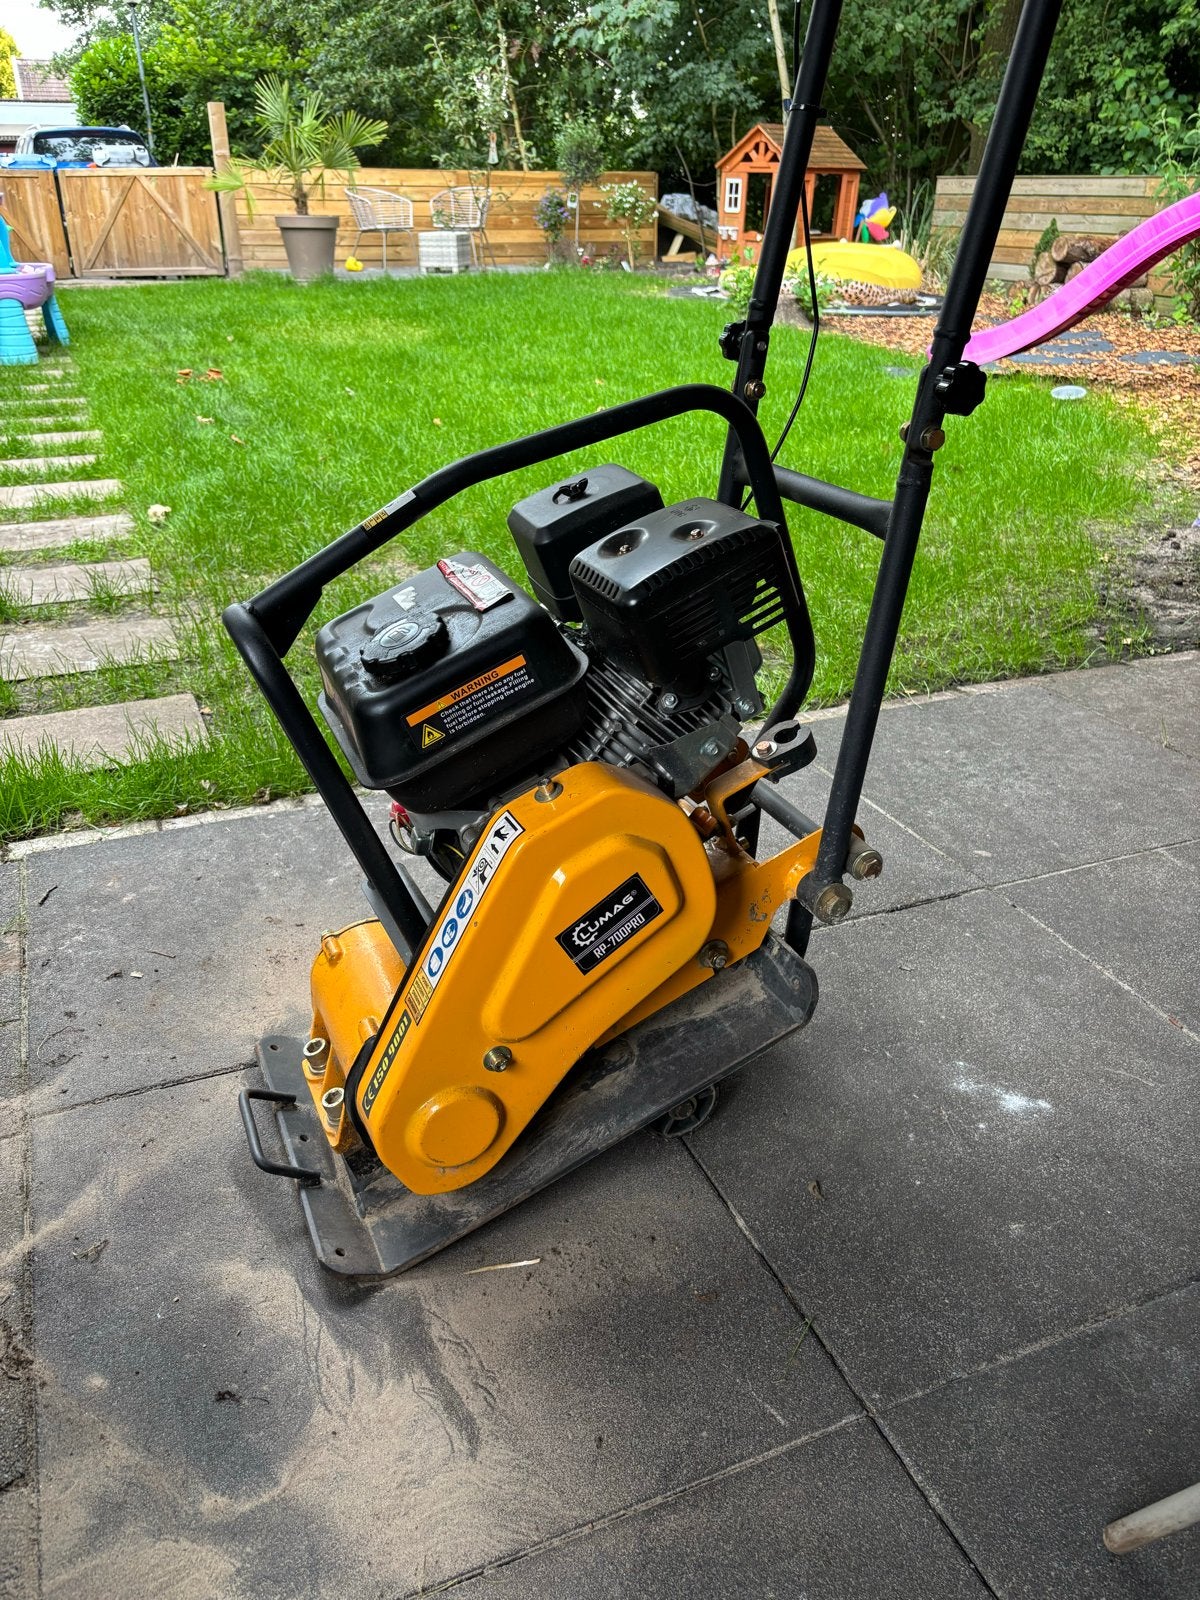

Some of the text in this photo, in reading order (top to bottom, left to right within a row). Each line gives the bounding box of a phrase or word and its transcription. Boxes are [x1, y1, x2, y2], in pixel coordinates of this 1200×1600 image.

[440, 668, 526, 718] Check that there is no any fuel
[446, 678, 535, 729] fuel before stopping the engine
[450, 670, 499, 701] WARNING
[443, 706, 466, 724] spilling
[466, 703, 473, 711] or
[473, 696, 486, 707] fuel
[593, 912, 646, 959] RP-700PRO
[373, 1056, 389, 1087] ISO
[388, 1015, 409, 1057] 9001
